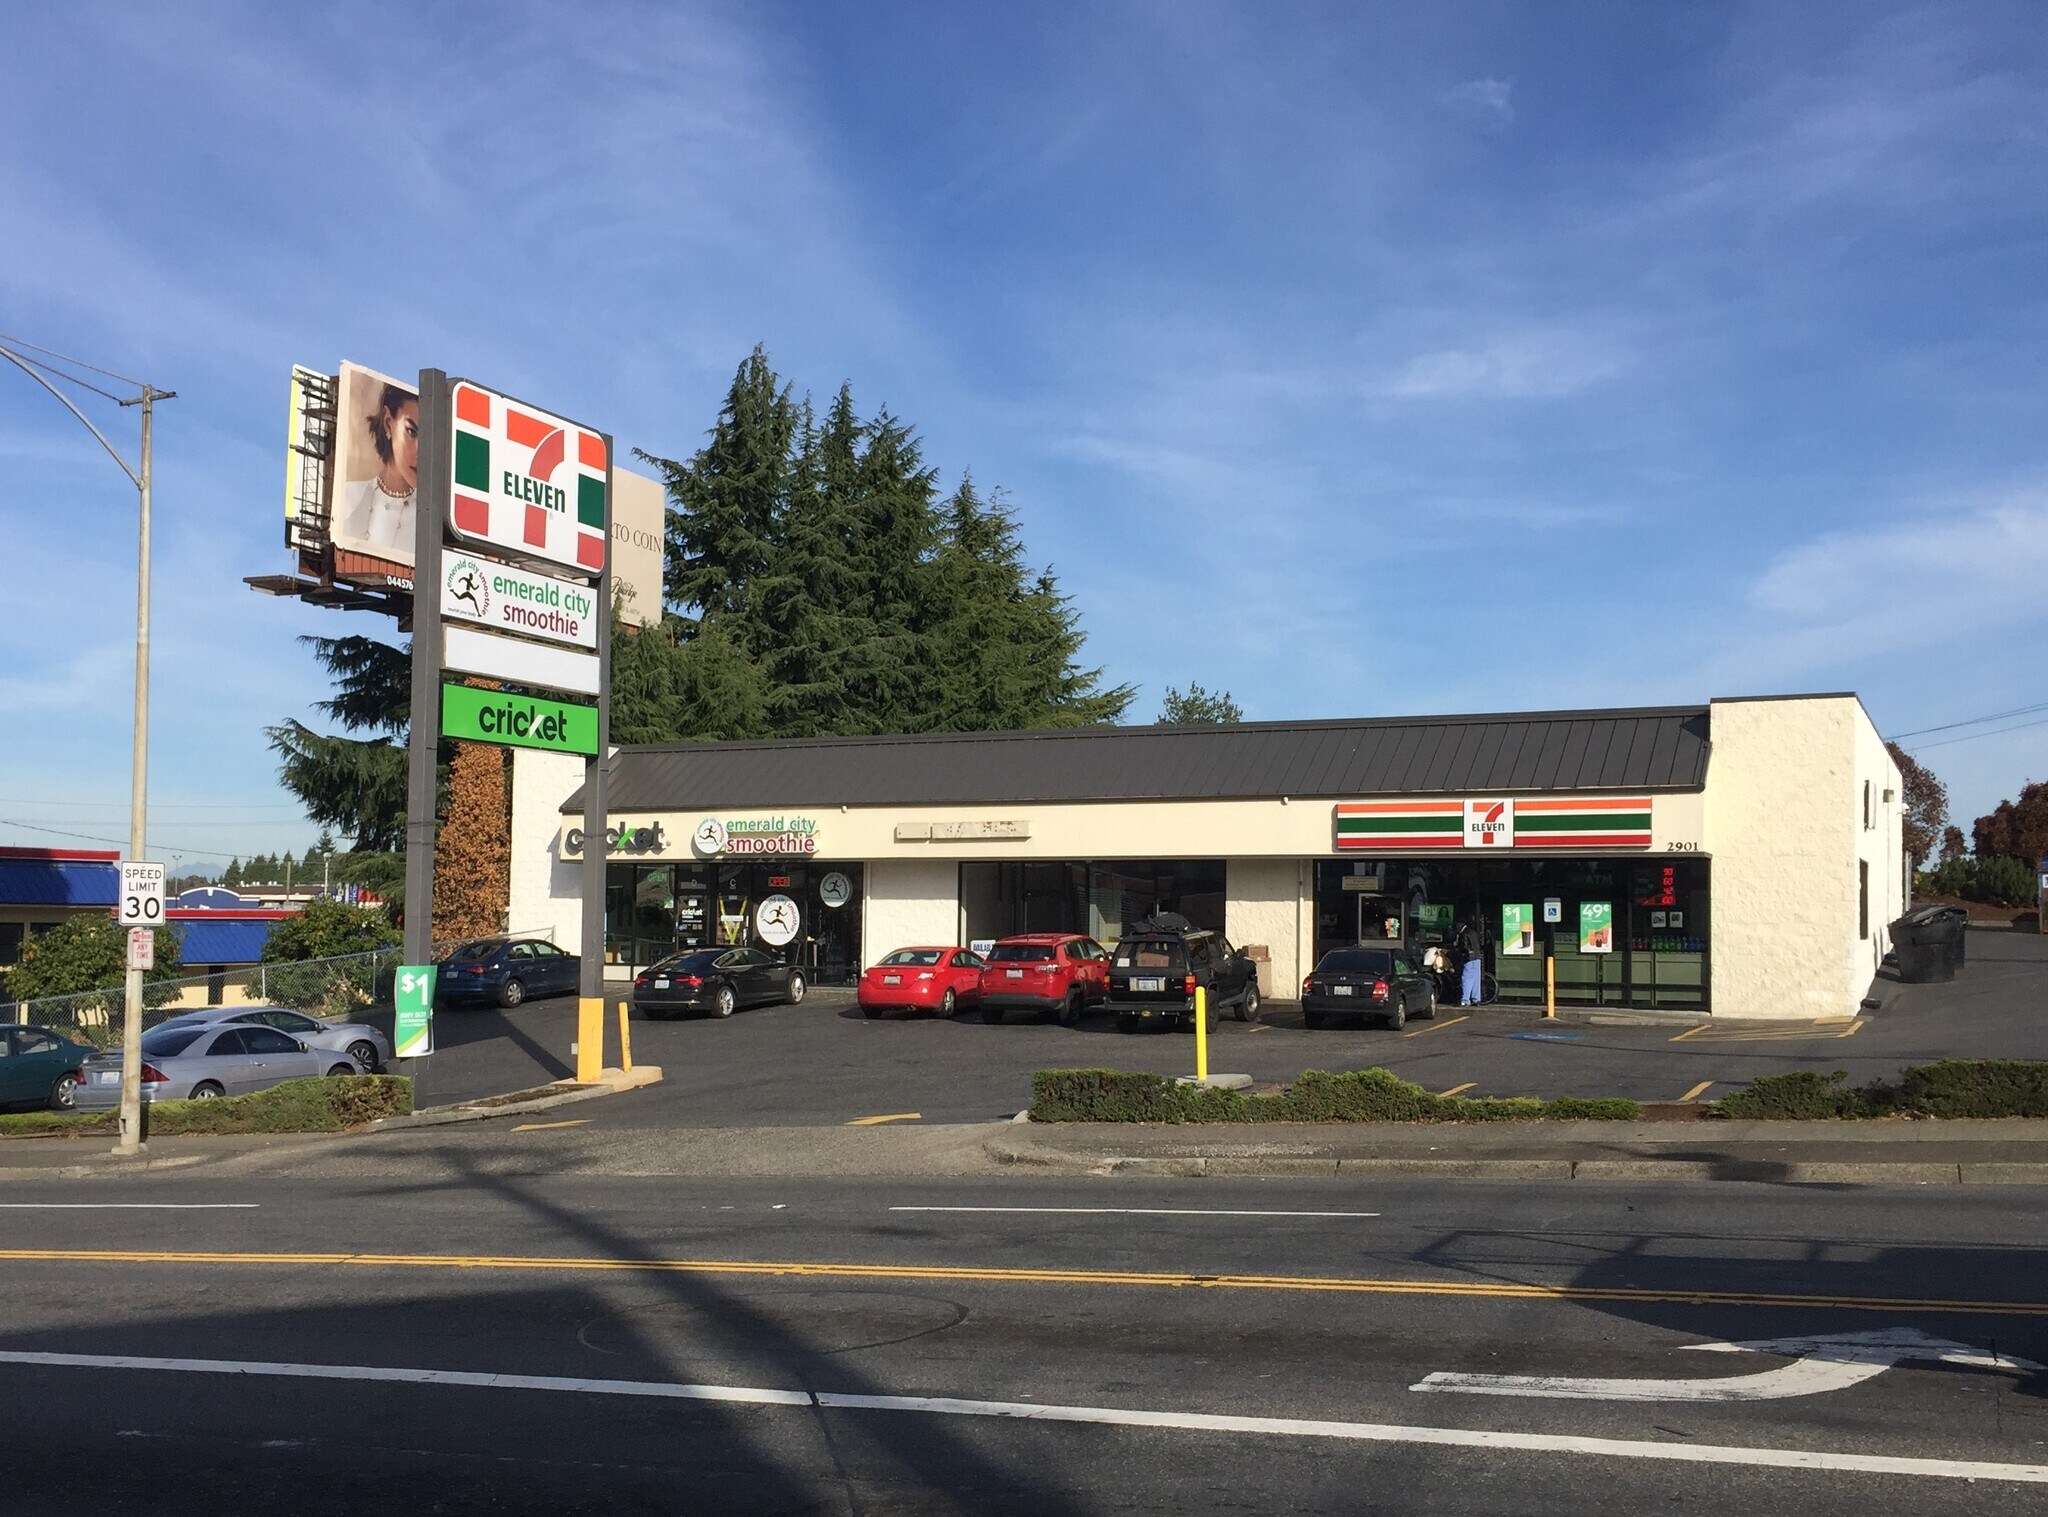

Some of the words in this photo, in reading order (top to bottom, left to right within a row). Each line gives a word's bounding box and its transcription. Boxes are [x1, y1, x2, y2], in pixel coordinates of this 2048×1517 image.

[507, 408, 565, 549] 7
[633, 529, 662, 554] COIN
[386, 575, 414, 591] 044576
[493, 575, 559, 607] emerald
[564, 589, 591, 620] city
[503, 604, 579, 637] smoothie
[478, 701, 568, 742] cricket
[726, 816, 784, 831] emerald
[789, 816, 816, 833] city
[566, 821, 665, 850] ccket
[726, 833, 815, 852] smoothie
[1667, 841, 1699, 852] 2901
[125, 868, 162, 879] SPEED
[128, 882, 157, 892] LIMIT
[125, 896, 160, 919] 30
[1504, 906, 1520, 922] $1
[137, 943, 148, 951] ANY
[400, 972, 429, 1006] $1
